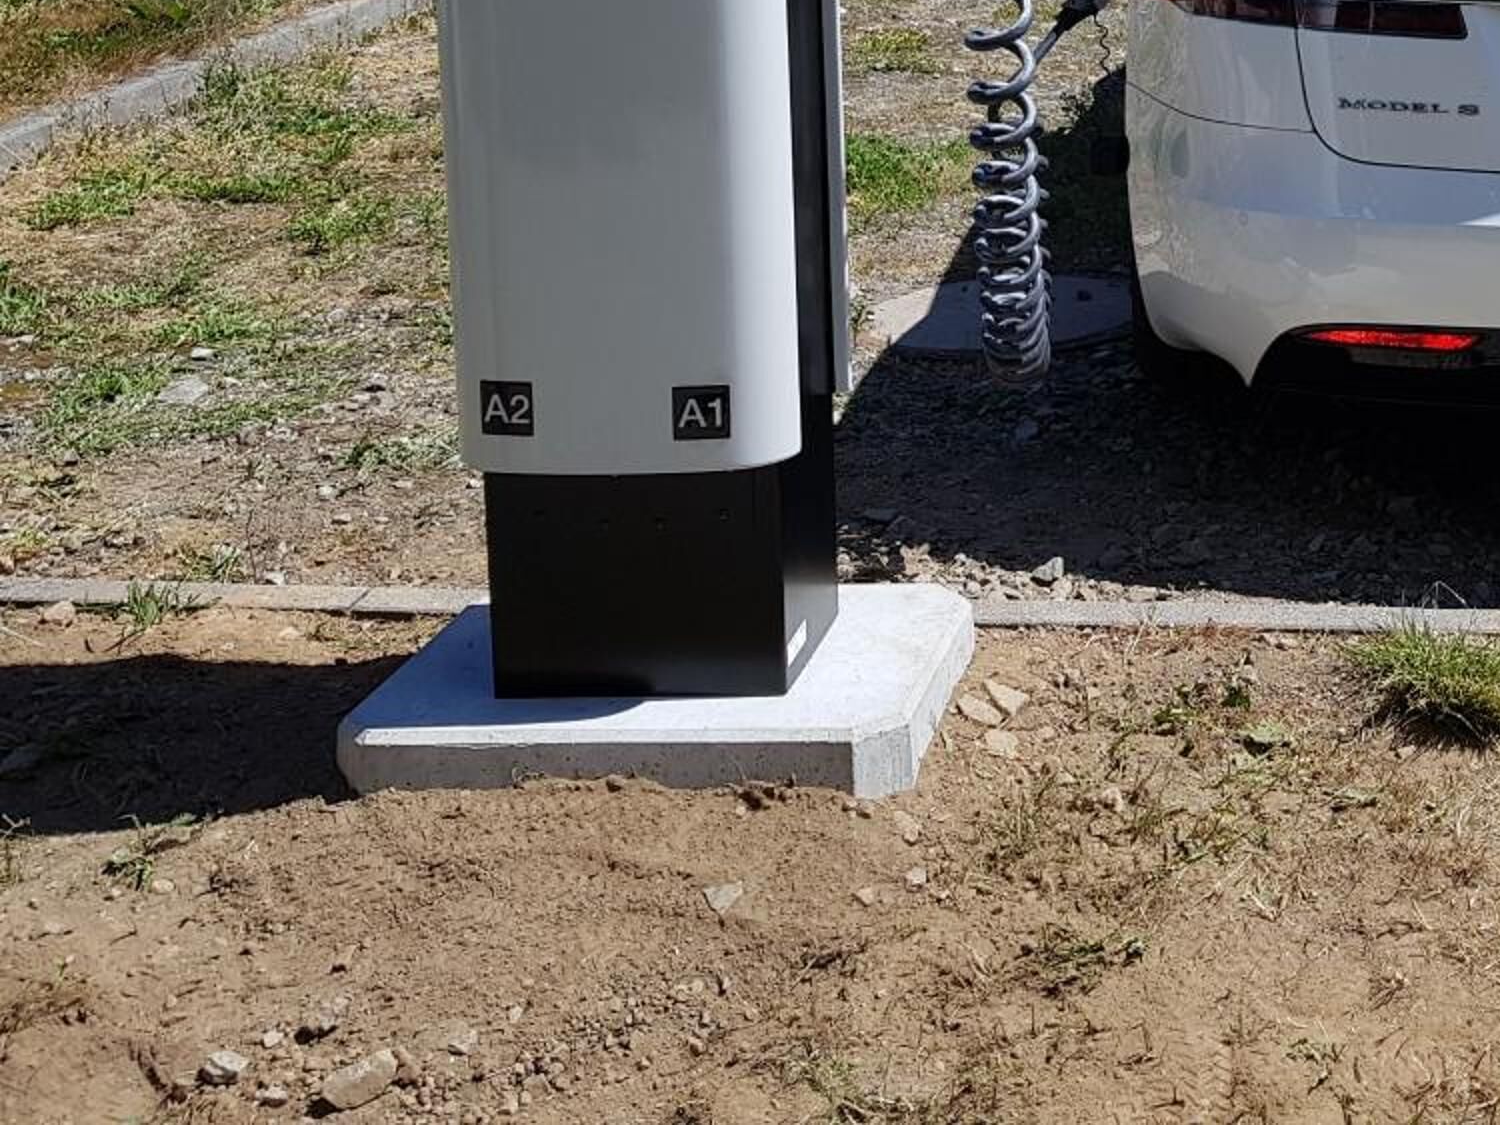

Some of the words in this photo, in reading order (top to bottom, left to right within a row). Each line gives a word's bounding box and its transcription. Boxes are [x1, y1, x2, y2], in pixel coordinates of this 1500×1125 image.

[1338, 97, 1449, 114] MODEL
[1457, 104, 1480, 116] S
[484, 394, 530, 424] A2
[678, 398, 724, 428] A1
